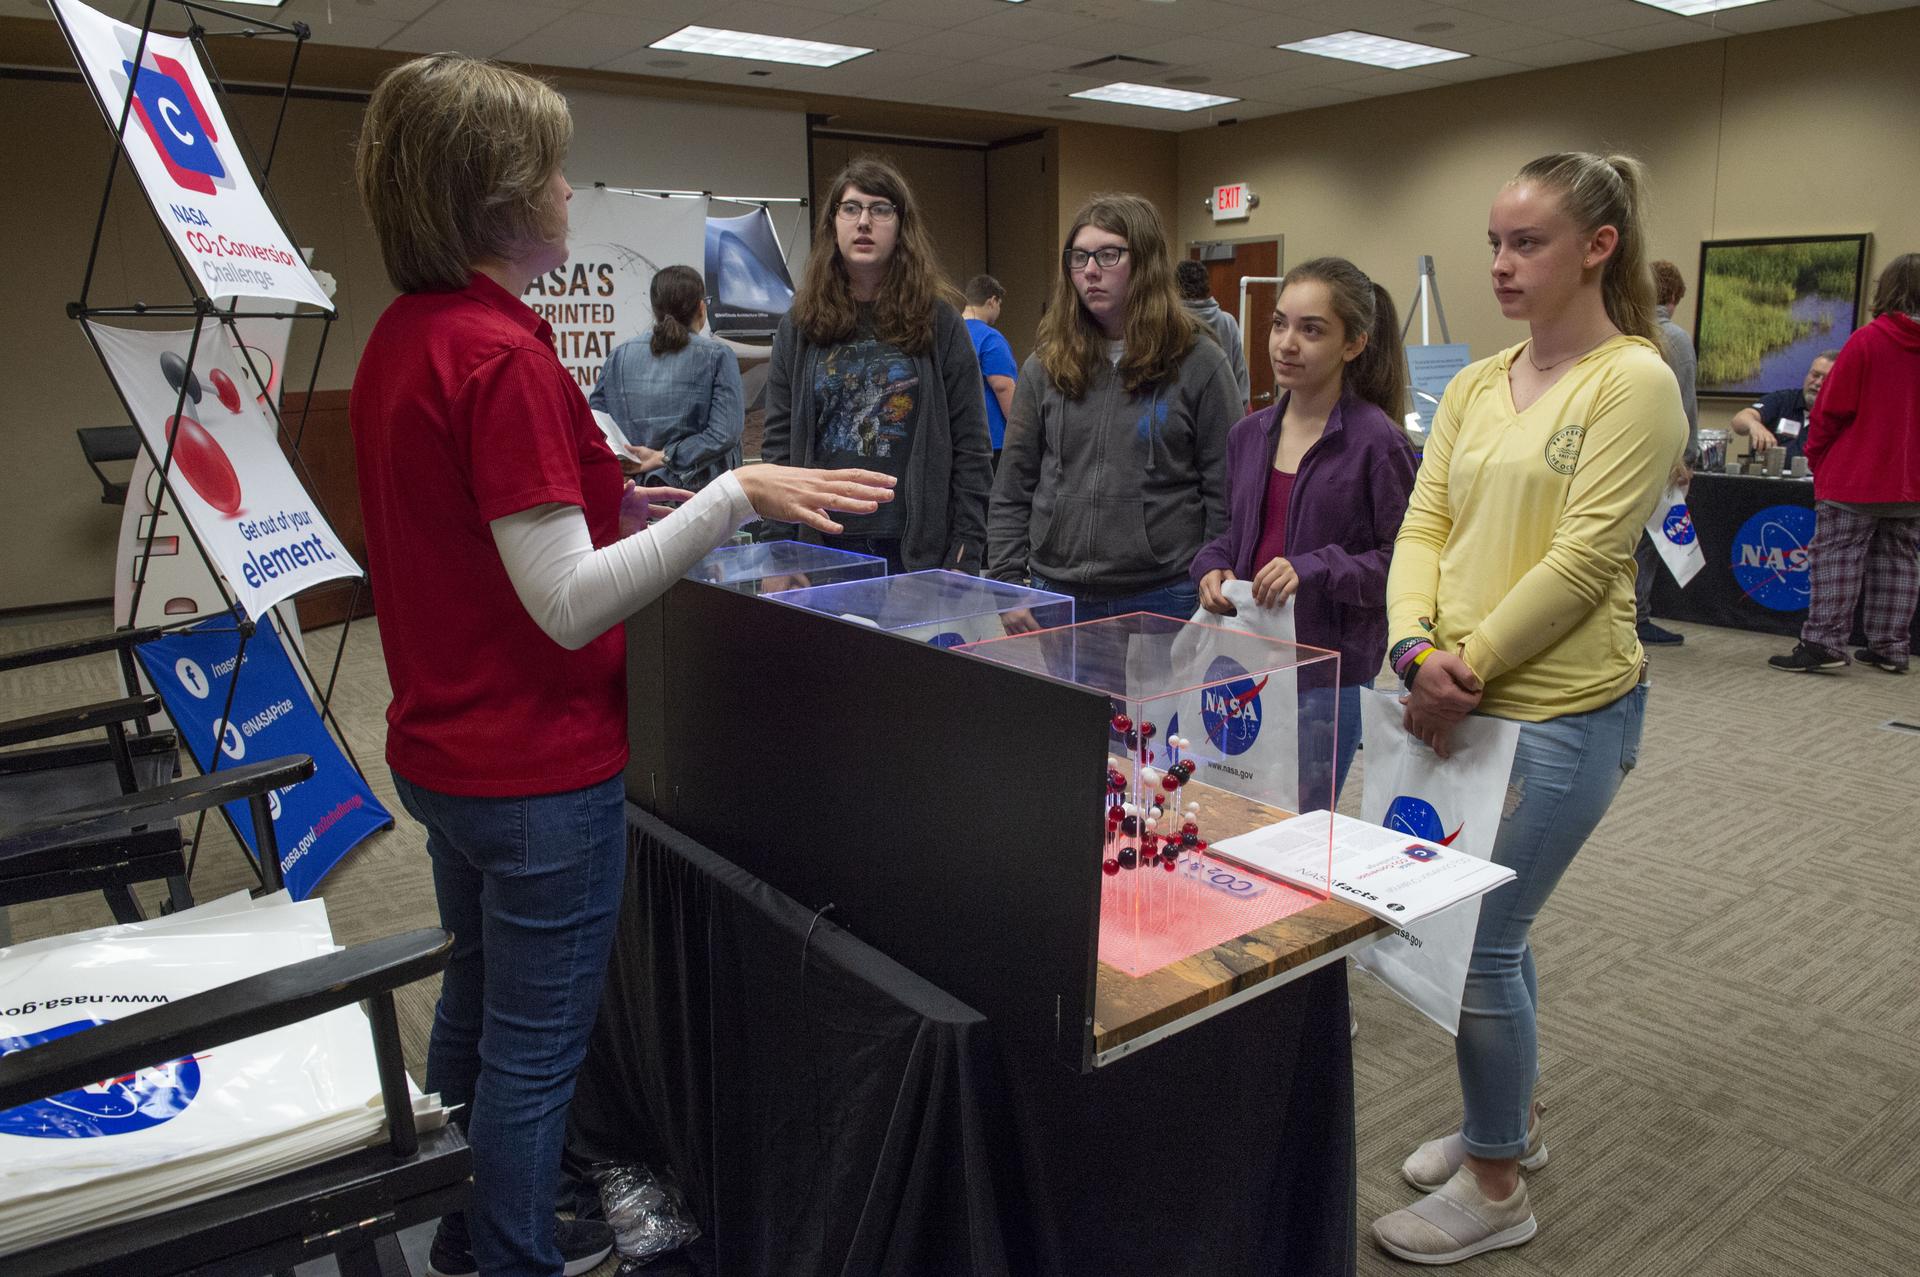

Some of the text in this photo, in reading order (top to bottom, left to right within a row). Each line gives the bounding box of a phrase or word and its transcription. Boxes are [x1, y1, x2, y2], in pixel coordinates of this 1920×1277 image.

[1218, 186, 1240, 210] EXIT
[169, 203, 212, 228] NASA
[203, 260, 275, 290] Challenge
[524, 263, 615, 298] ASA'S
[1552, 430, 1584, 446] PROPERT
[238, 510, 313, 541] Get out of your
[1666, 513, 1690, 538] NAS
[242, 533, 337, 589] element.
[1739, 543, 1809, 572] NAS
[241, 698, 294, 738] @NASAPrize
[1204, 689, 1259, 722] NASA
[1207, 760, 1254, 780] www.nasa.gov
[1393, 926, 1423, 949] asa.gov
